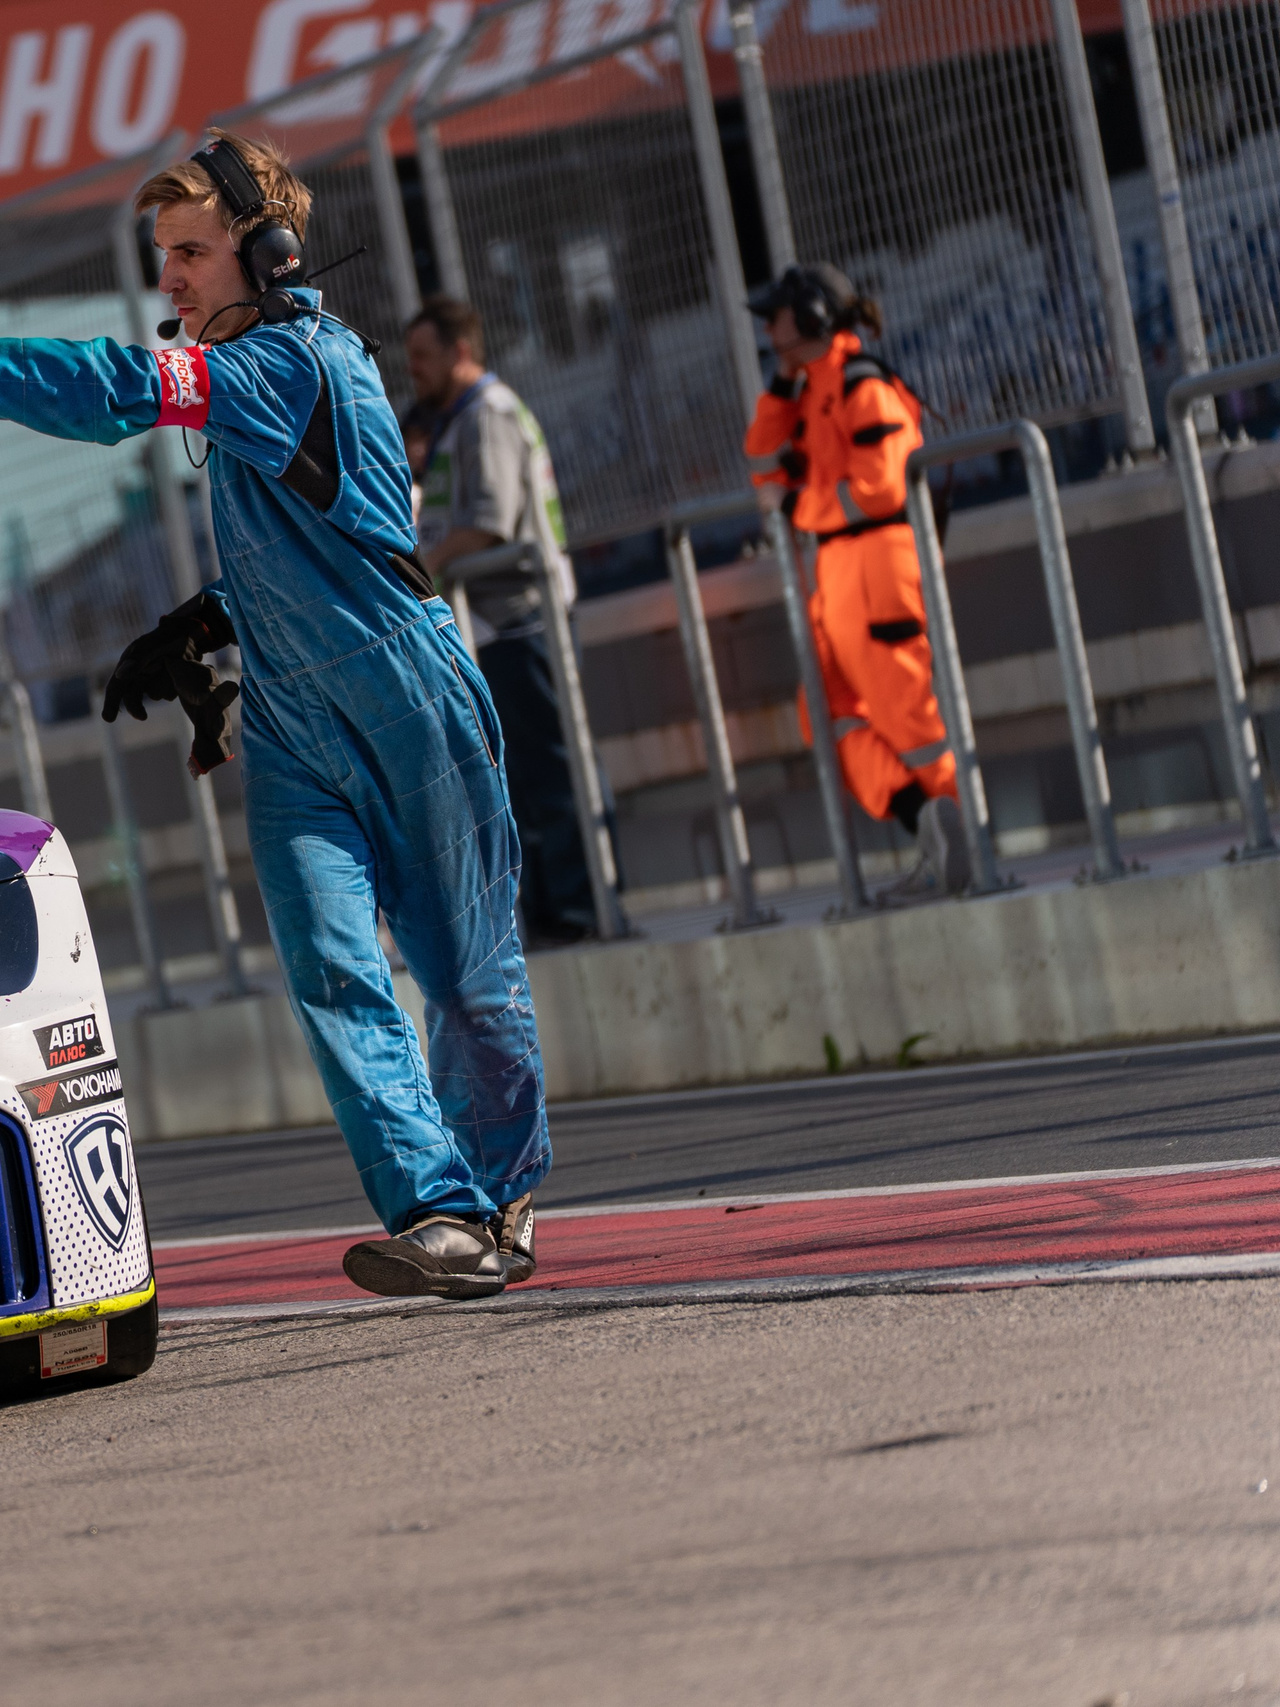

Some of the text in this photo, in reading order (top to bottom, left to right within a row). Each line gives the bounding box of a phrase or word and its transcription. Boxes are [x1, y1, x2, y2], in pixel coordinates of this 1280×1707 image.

[272, 256, 301, 278] Stilo
[48, 1017, 96, 1051] АВТО
[48, 1043, 87, 1067] ПЛЮС
